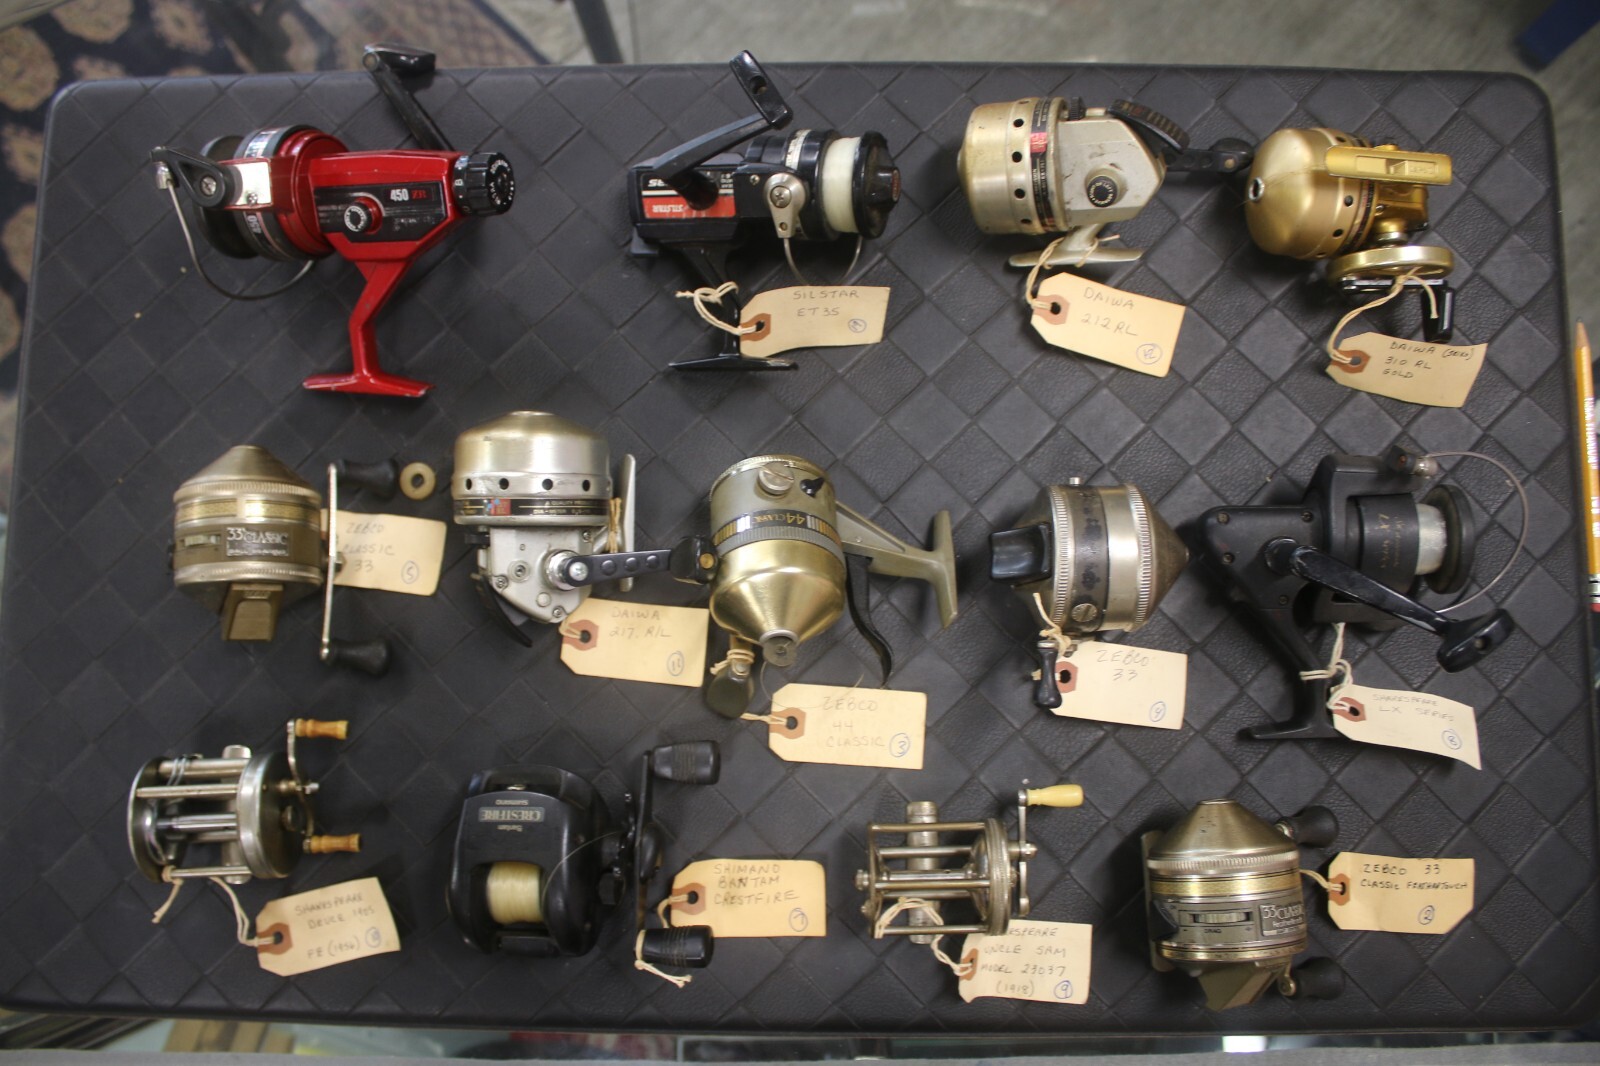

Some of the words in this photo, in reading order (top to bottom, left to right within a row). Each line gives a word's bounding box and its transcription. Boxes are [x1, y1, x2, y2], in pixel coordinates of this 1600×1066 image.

[390, 188, 409, 201] 450
[792, 289, 860, 300] SILSTAR
[1083, 286, 1135, 310] DAIWA
[1389, 341, 1436, 354] DAIWA
[1384, 356, 1408, 366] 310
[1414, 359, 1433, 370] RL
[1382, 368, 1414, 379] GOLD
[785, 512, 806, 525] 44
[226, 527, 244, 541] 33
[243, 530, 289, 545] CLASSIC
[342, 543, 396, 556] CLASSIC
[354, 559, 375, 573] 33
[611, 606, 661, 621] DAIWA
[1096, 649, 1151, 667] ZEBCO
[1112, 668, 1138, 682] 33
[822, 696, 879, 712] ZEBCO
[832, 719, 854, 733] 44
[825, 735, 886, 748] CLASSIC
[481, 809, 542, 821] CRESTFIRE
[714, 863, 781, 875] SHIMANO
[1362, 863, 1407, 876] ZEBCO
[1423, 863, 1440, 875] 33
[717, 875, 781, 889] BANTAM
[1360, 878, 1401, 890] CLASSIC
[713, 889, 800, 906] CRESTFIRE
[1262, 905, 1277, 919] 33
[984, 944, 1022, 955] UNCLE
[1036, 945, 1067, 958] SAM
[980, 963, 1013, 974] MODEL
[1020, 963, 1067, 977] 23037
